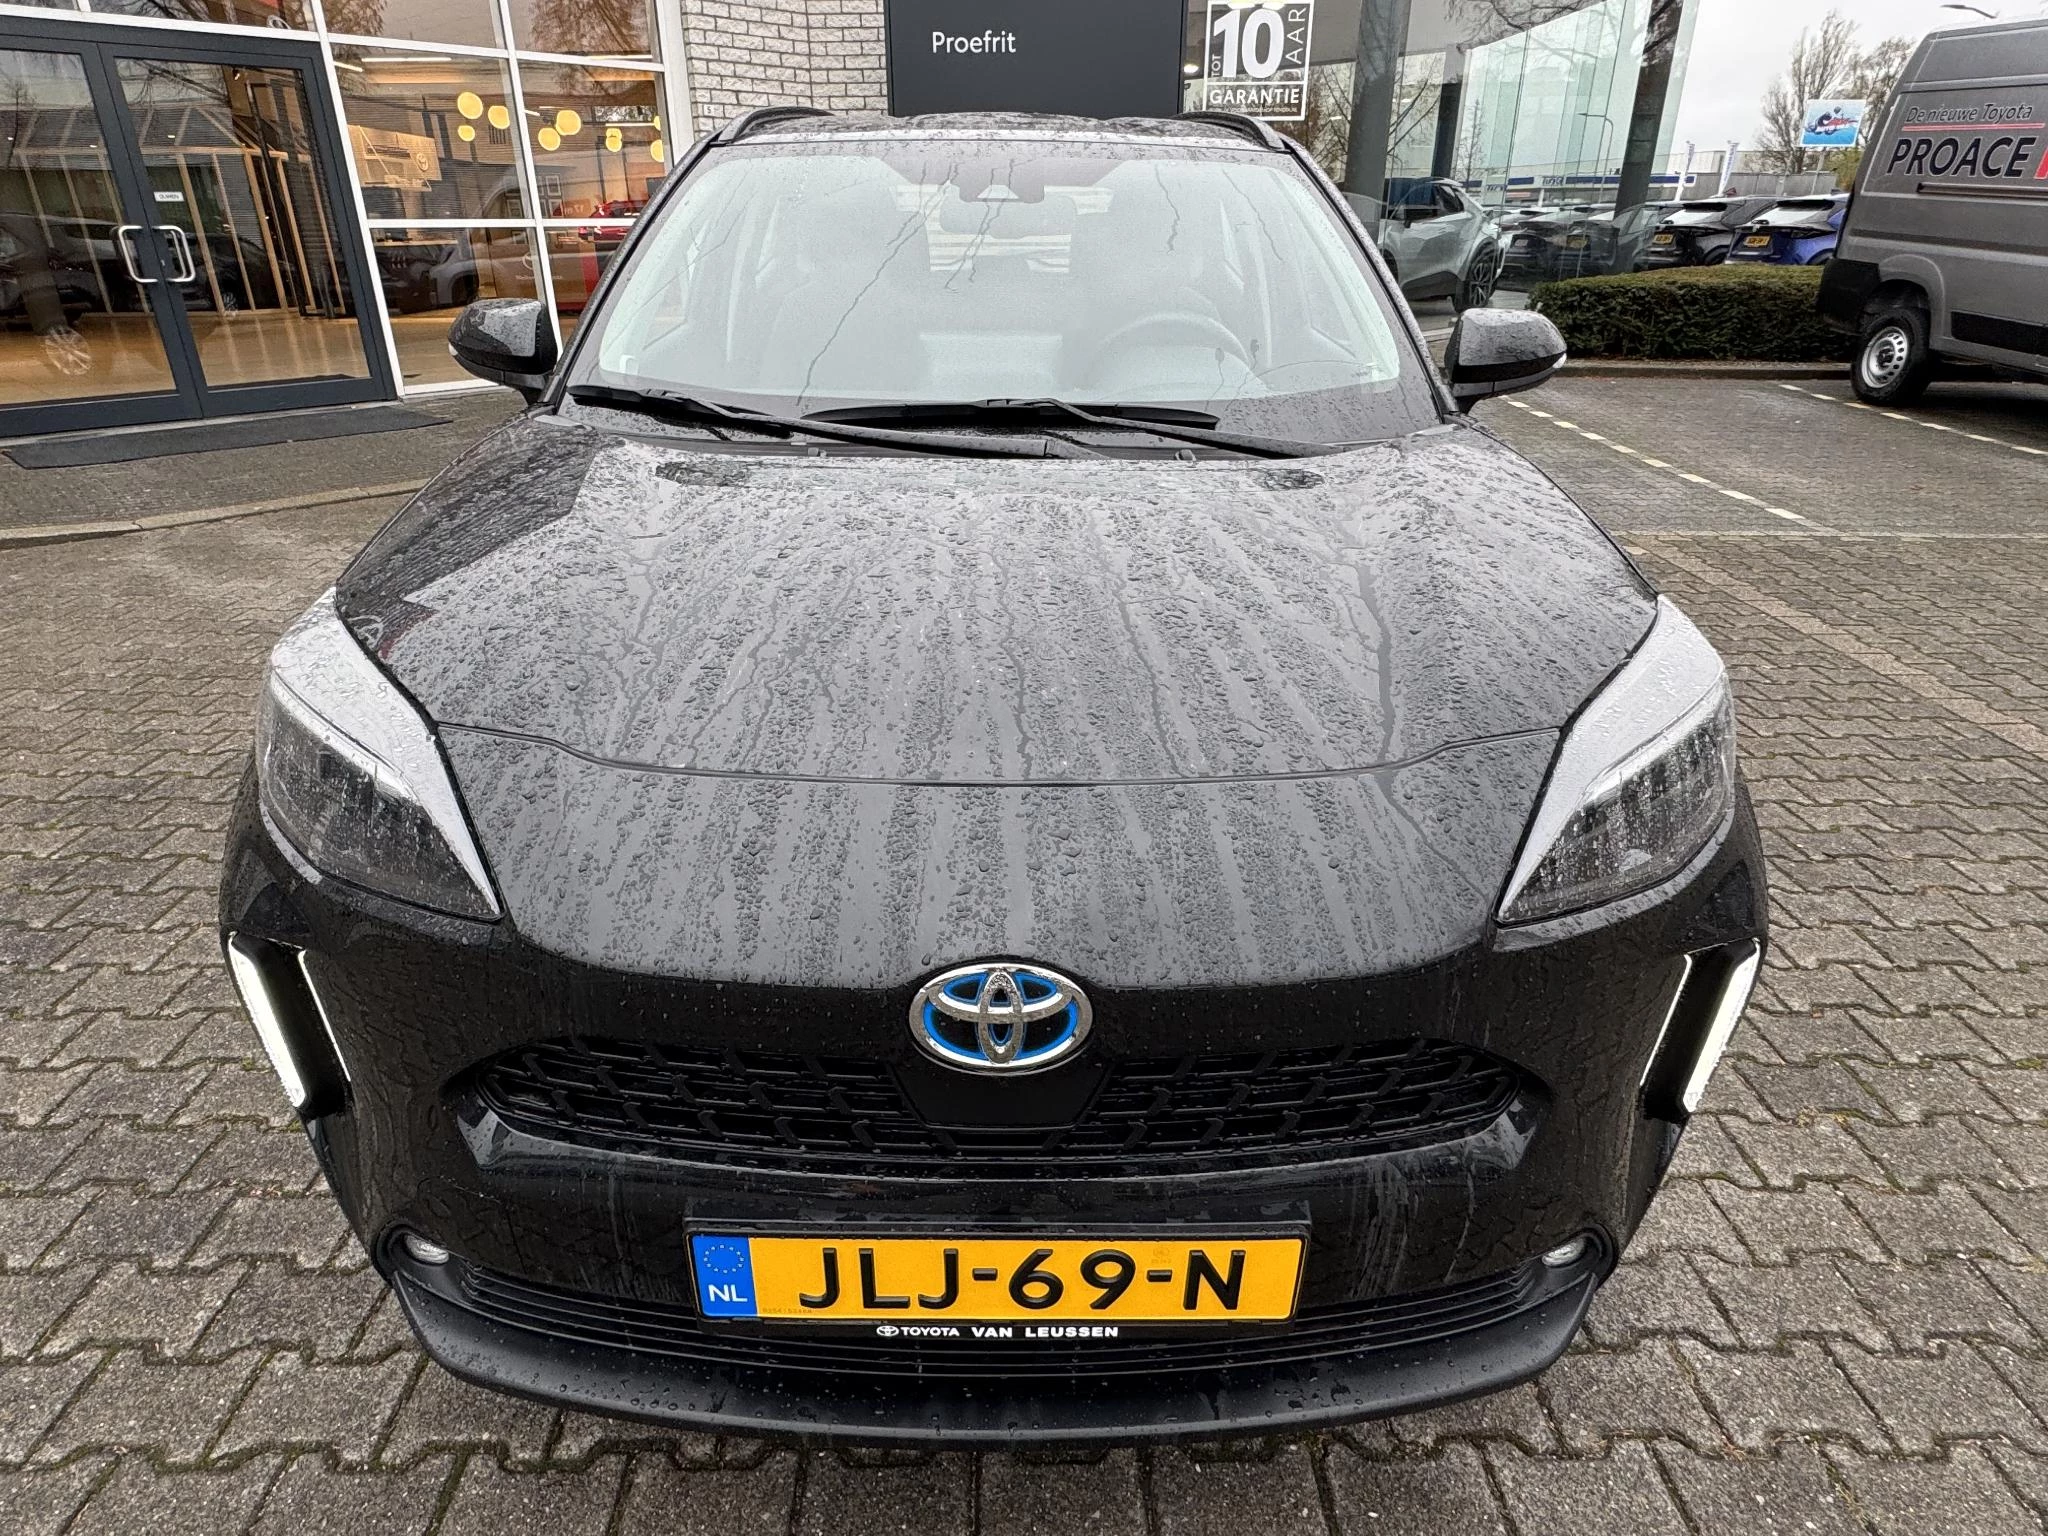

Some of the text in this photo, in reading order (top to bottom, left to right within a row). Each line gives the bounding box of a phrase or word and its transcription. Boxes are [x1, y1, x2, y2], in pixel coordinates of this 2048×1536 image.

[932, 30, 1016, 53] Proefrit
[1213, 8, 1285, 78] 10
[1285, 7, 1306, 78] JAAR
[1211, 54, 1221, 78] TOT
[1209, 88, 1300, 105] GARANTIE
[1906, 103, 2033, 125] De nieuwe Toyota
[1886, 136, 2037, 178] PROACE
[799, 1247, 1247, 1310] JLJ-69-N
[708, 1284, 748, 1303] NL
[900, 1326, 1119, 1338] TOYOTA VAN LEUSSEN
